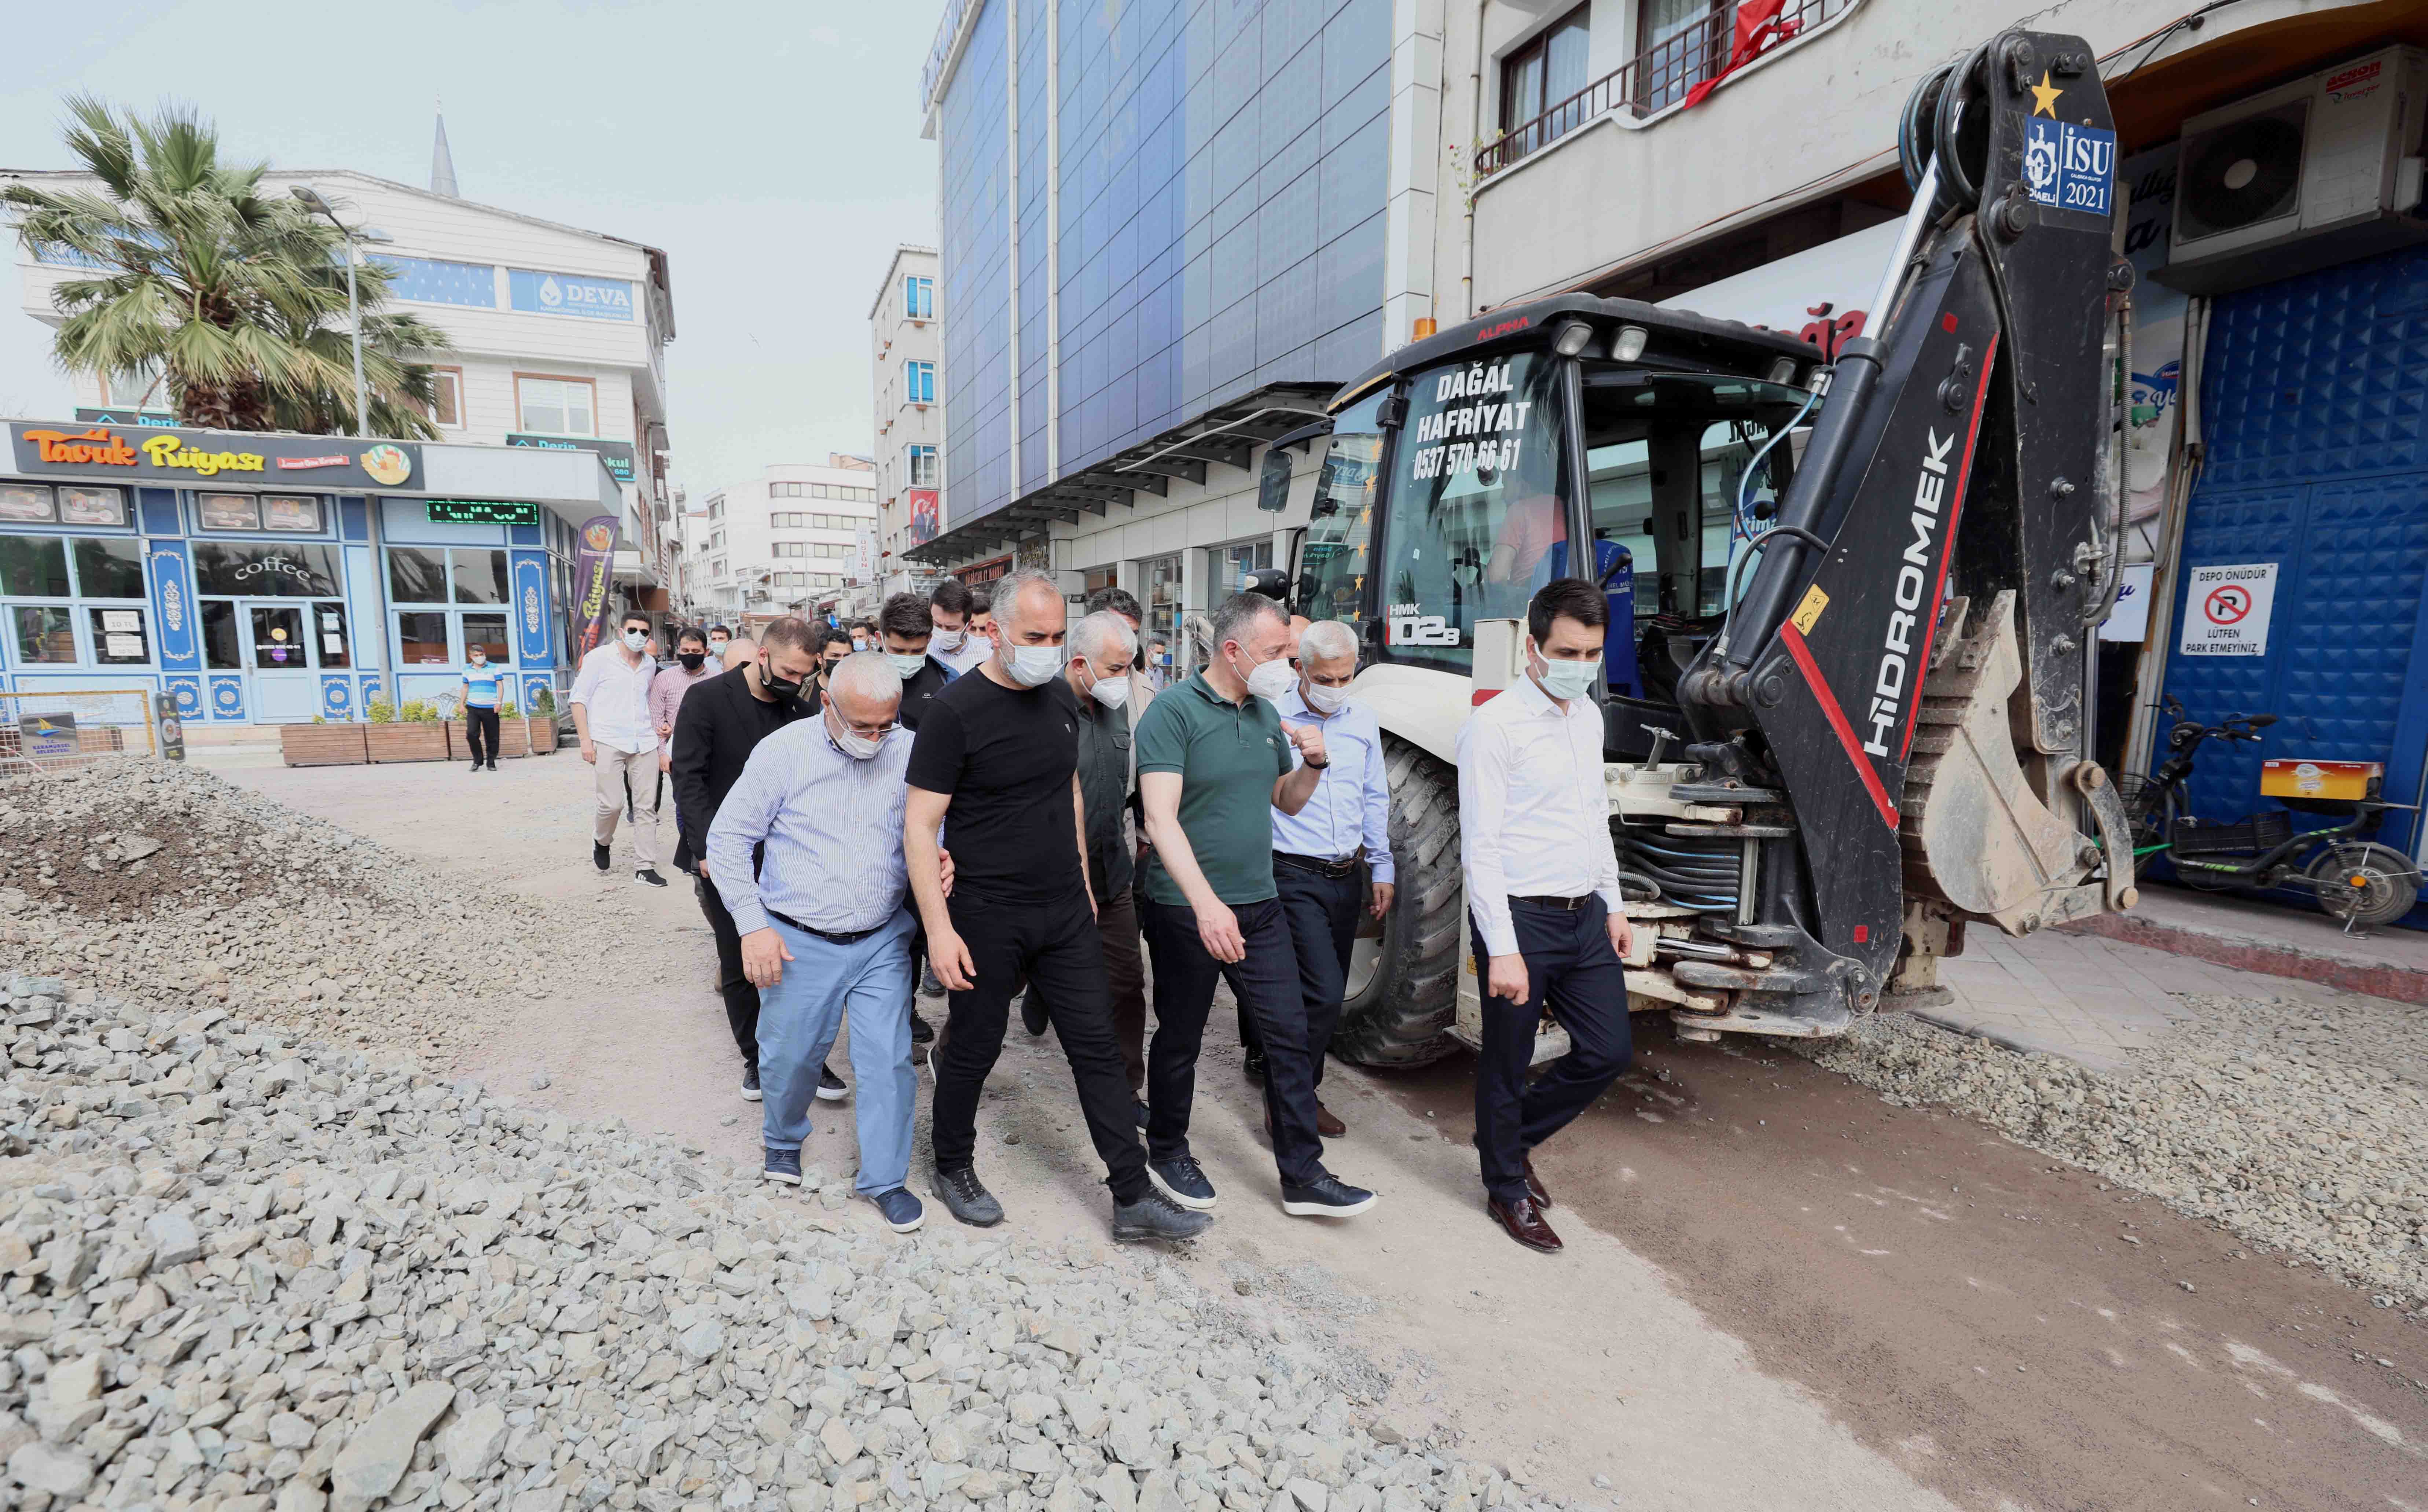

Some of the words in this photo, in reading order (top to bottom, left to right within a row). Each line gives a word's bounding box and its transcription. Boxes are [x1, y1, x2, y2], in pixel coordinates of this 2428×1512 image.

[2063, 127, 2112, 175] İSU
[2065, 182, 2104, 209] 2021
[566, 284, 629, 306] DEVA
[1477, 316, 1529, 341] ALPHA
[1436, 361, 1514, 402] DAĞAL
[1417, 400, 1531, 443] HAFRİYAT
[23, 428, 138, 466] Tavuk
[142, 435, 264, 476] Rüyası
[1414, 445, 1446, 480] 0537
[1446, 442, 1474, 475] 570
[1500, 439, 1521, 471] 61
[235, 556, 310, 581] coffee
[2199, 571, 2223, 582] DEPO
[2226, 567, 2267, 580] ÖNÜDÜR
[1389, 603, 1421, 615] HMK
[2207, 626, 2240, 639] LÜTFEN
[2186, 643, 2208, 653] PARK
